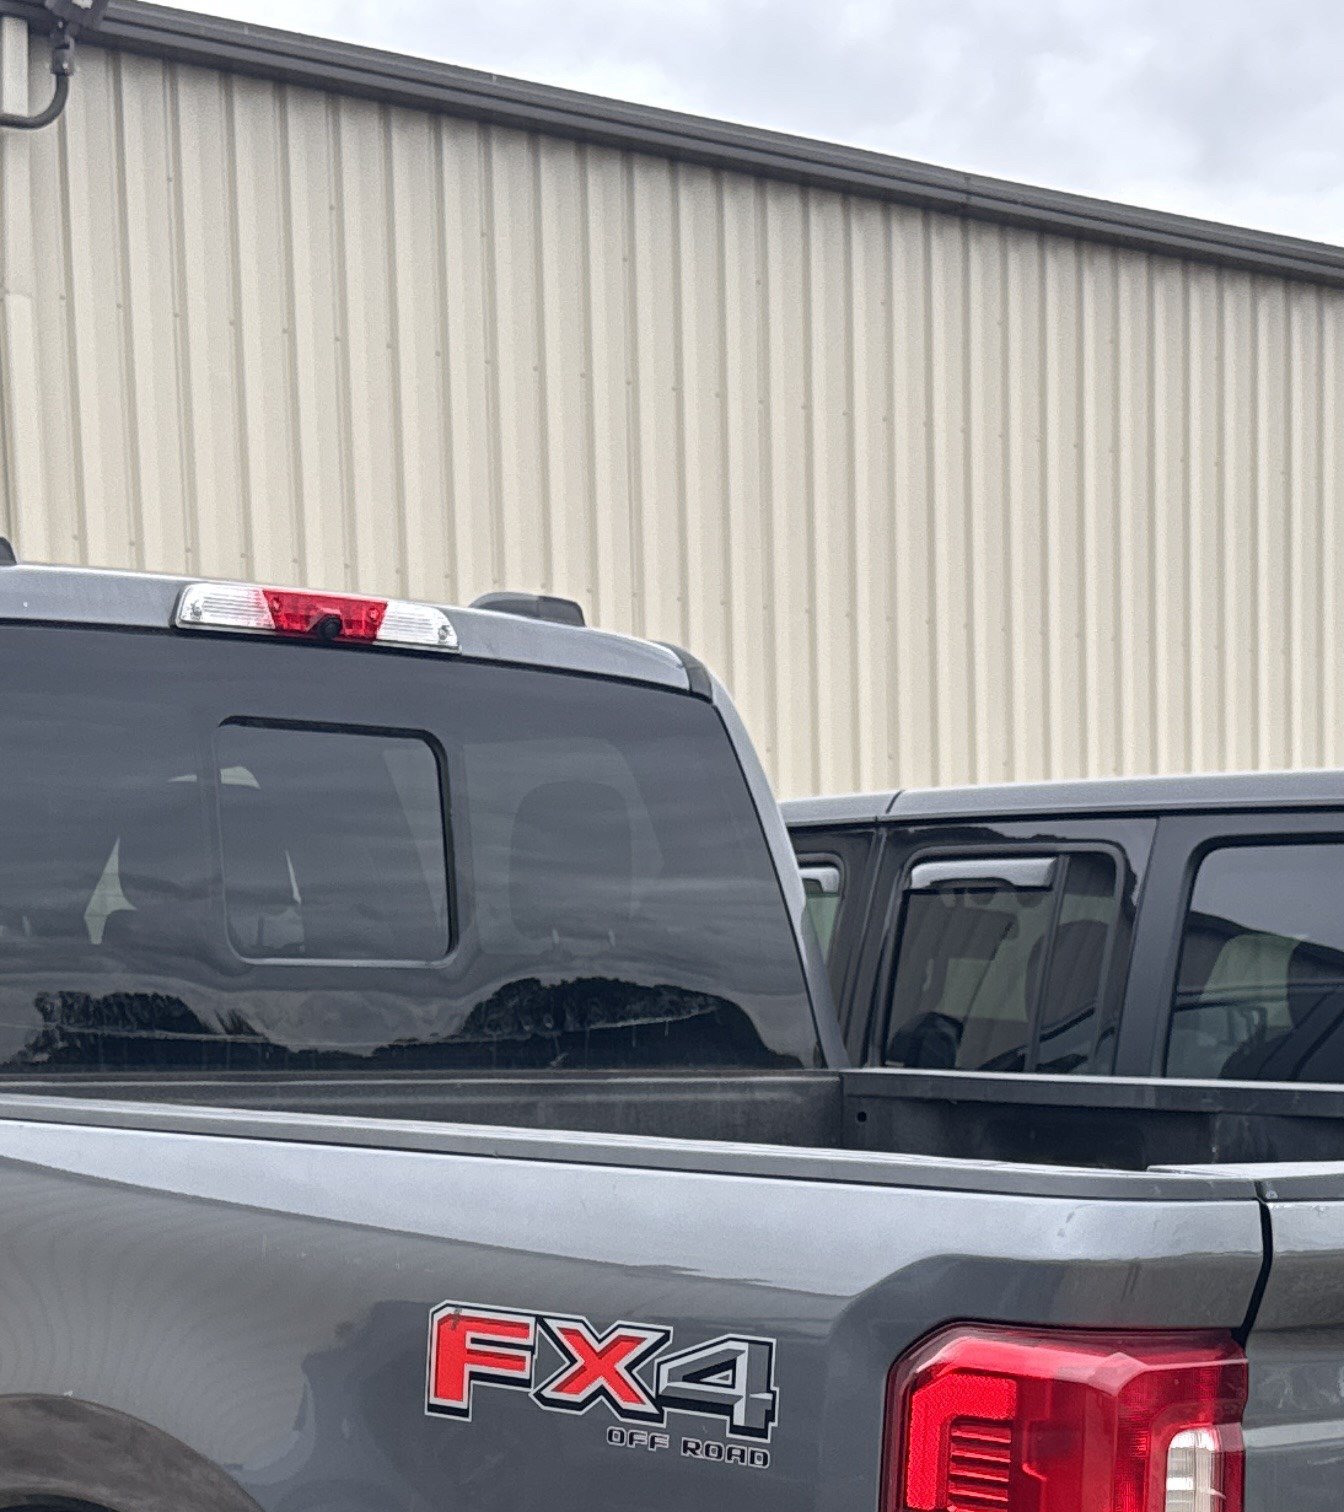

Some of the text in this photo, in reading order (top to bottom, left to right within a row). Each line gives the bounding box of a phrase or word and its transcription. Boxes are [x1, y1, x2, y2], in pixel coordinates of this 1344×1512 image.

[425, 1300, 779, 1443] FX4
[606, 1426, 771, 1468] OFF ROAD
